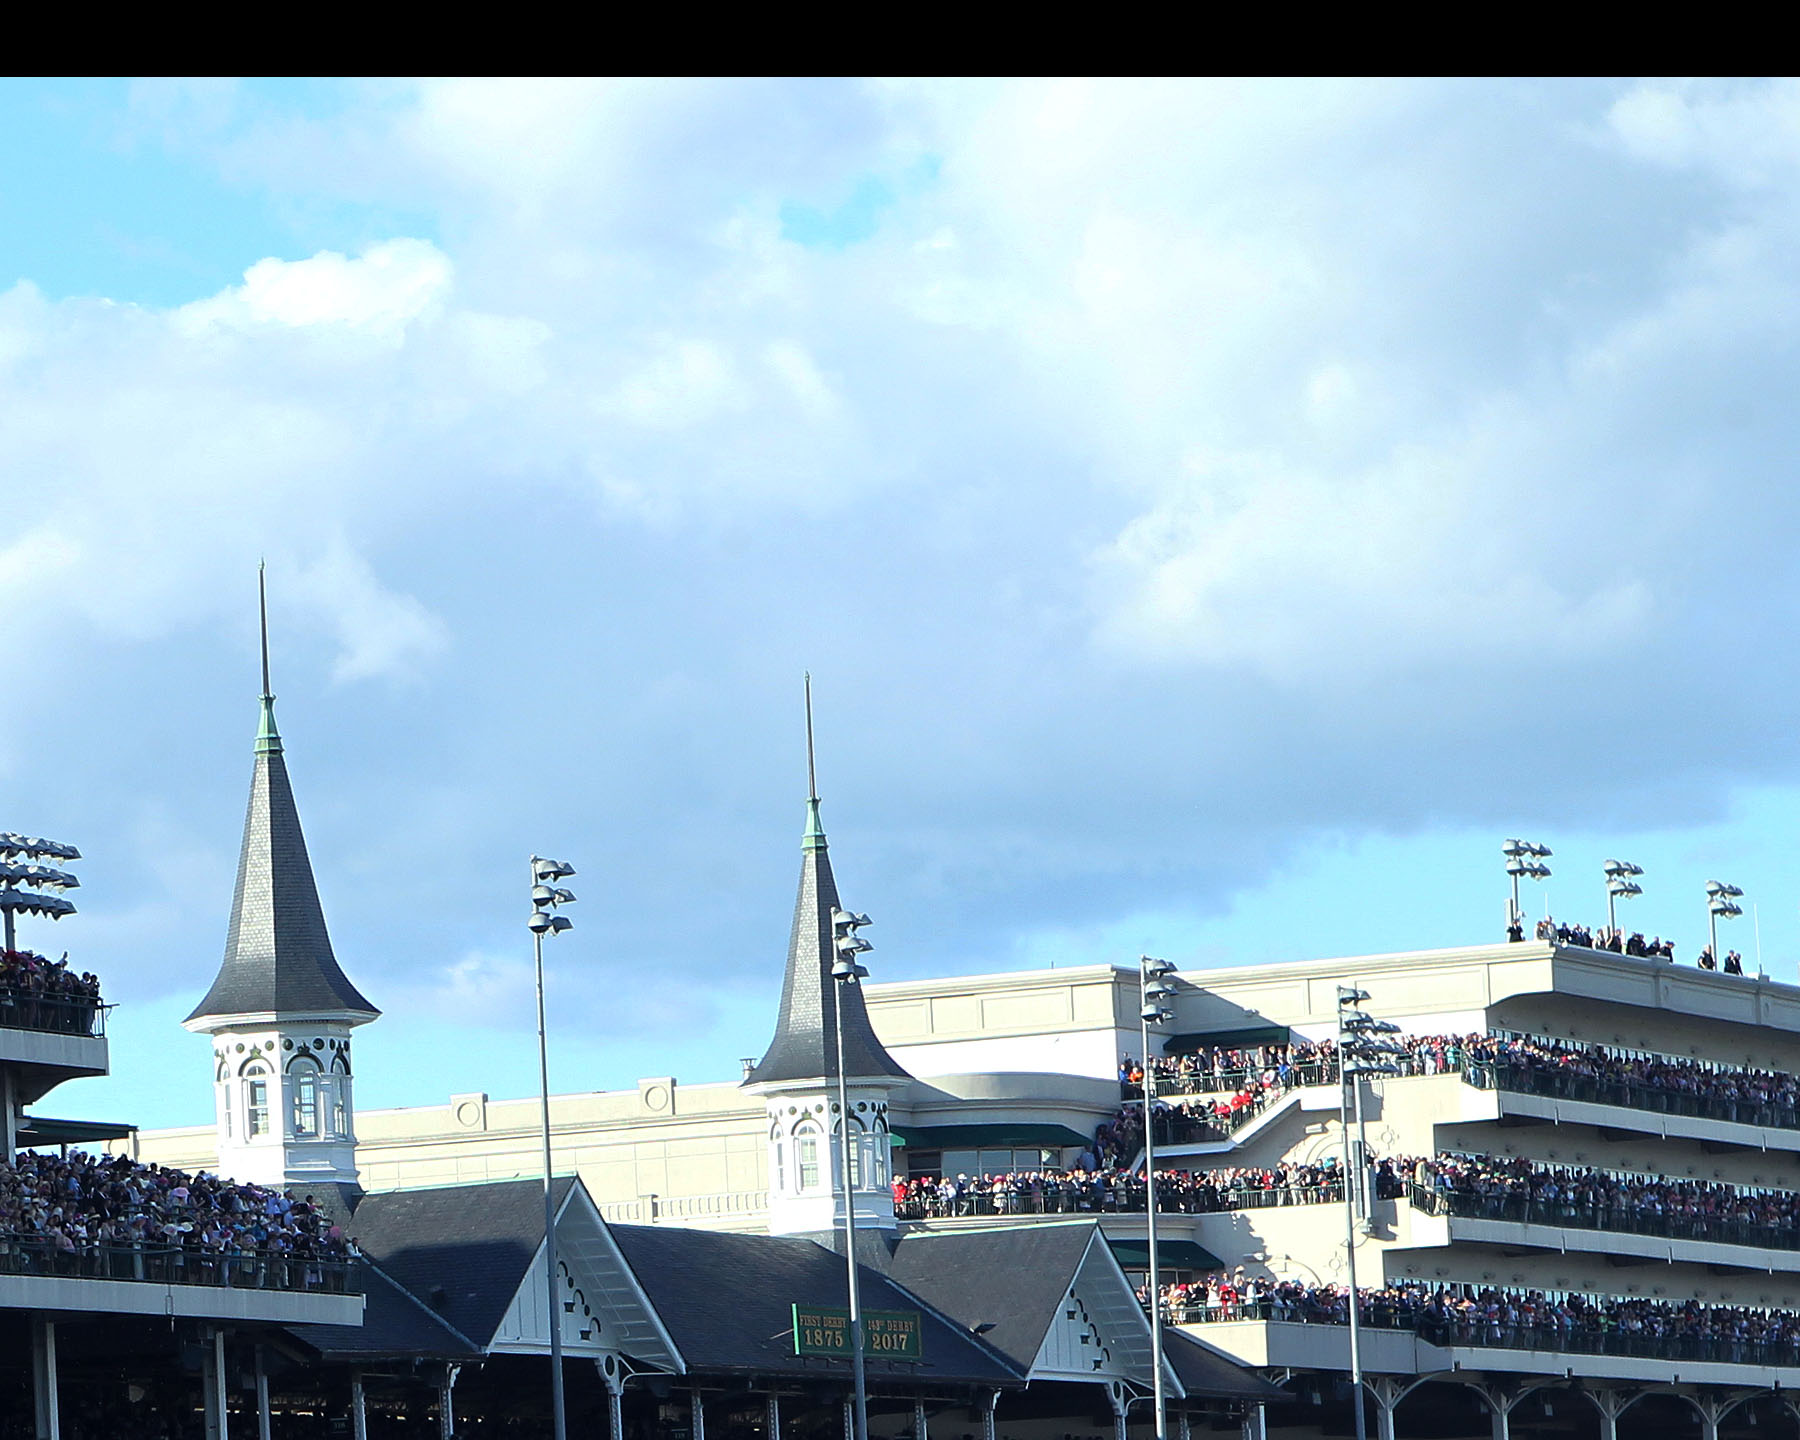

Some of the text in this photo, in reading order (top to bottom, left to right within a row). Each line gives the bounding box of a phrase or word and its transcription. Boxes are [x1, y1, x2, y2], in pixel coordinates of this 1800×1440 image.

[799, 1315, 846, 1328] FIRST DERBY
[887, 1320, 913, 1332] DERBY
[804, 1329, 843, 1347] 1875
[872, 1333, 908, 1350] 2017
